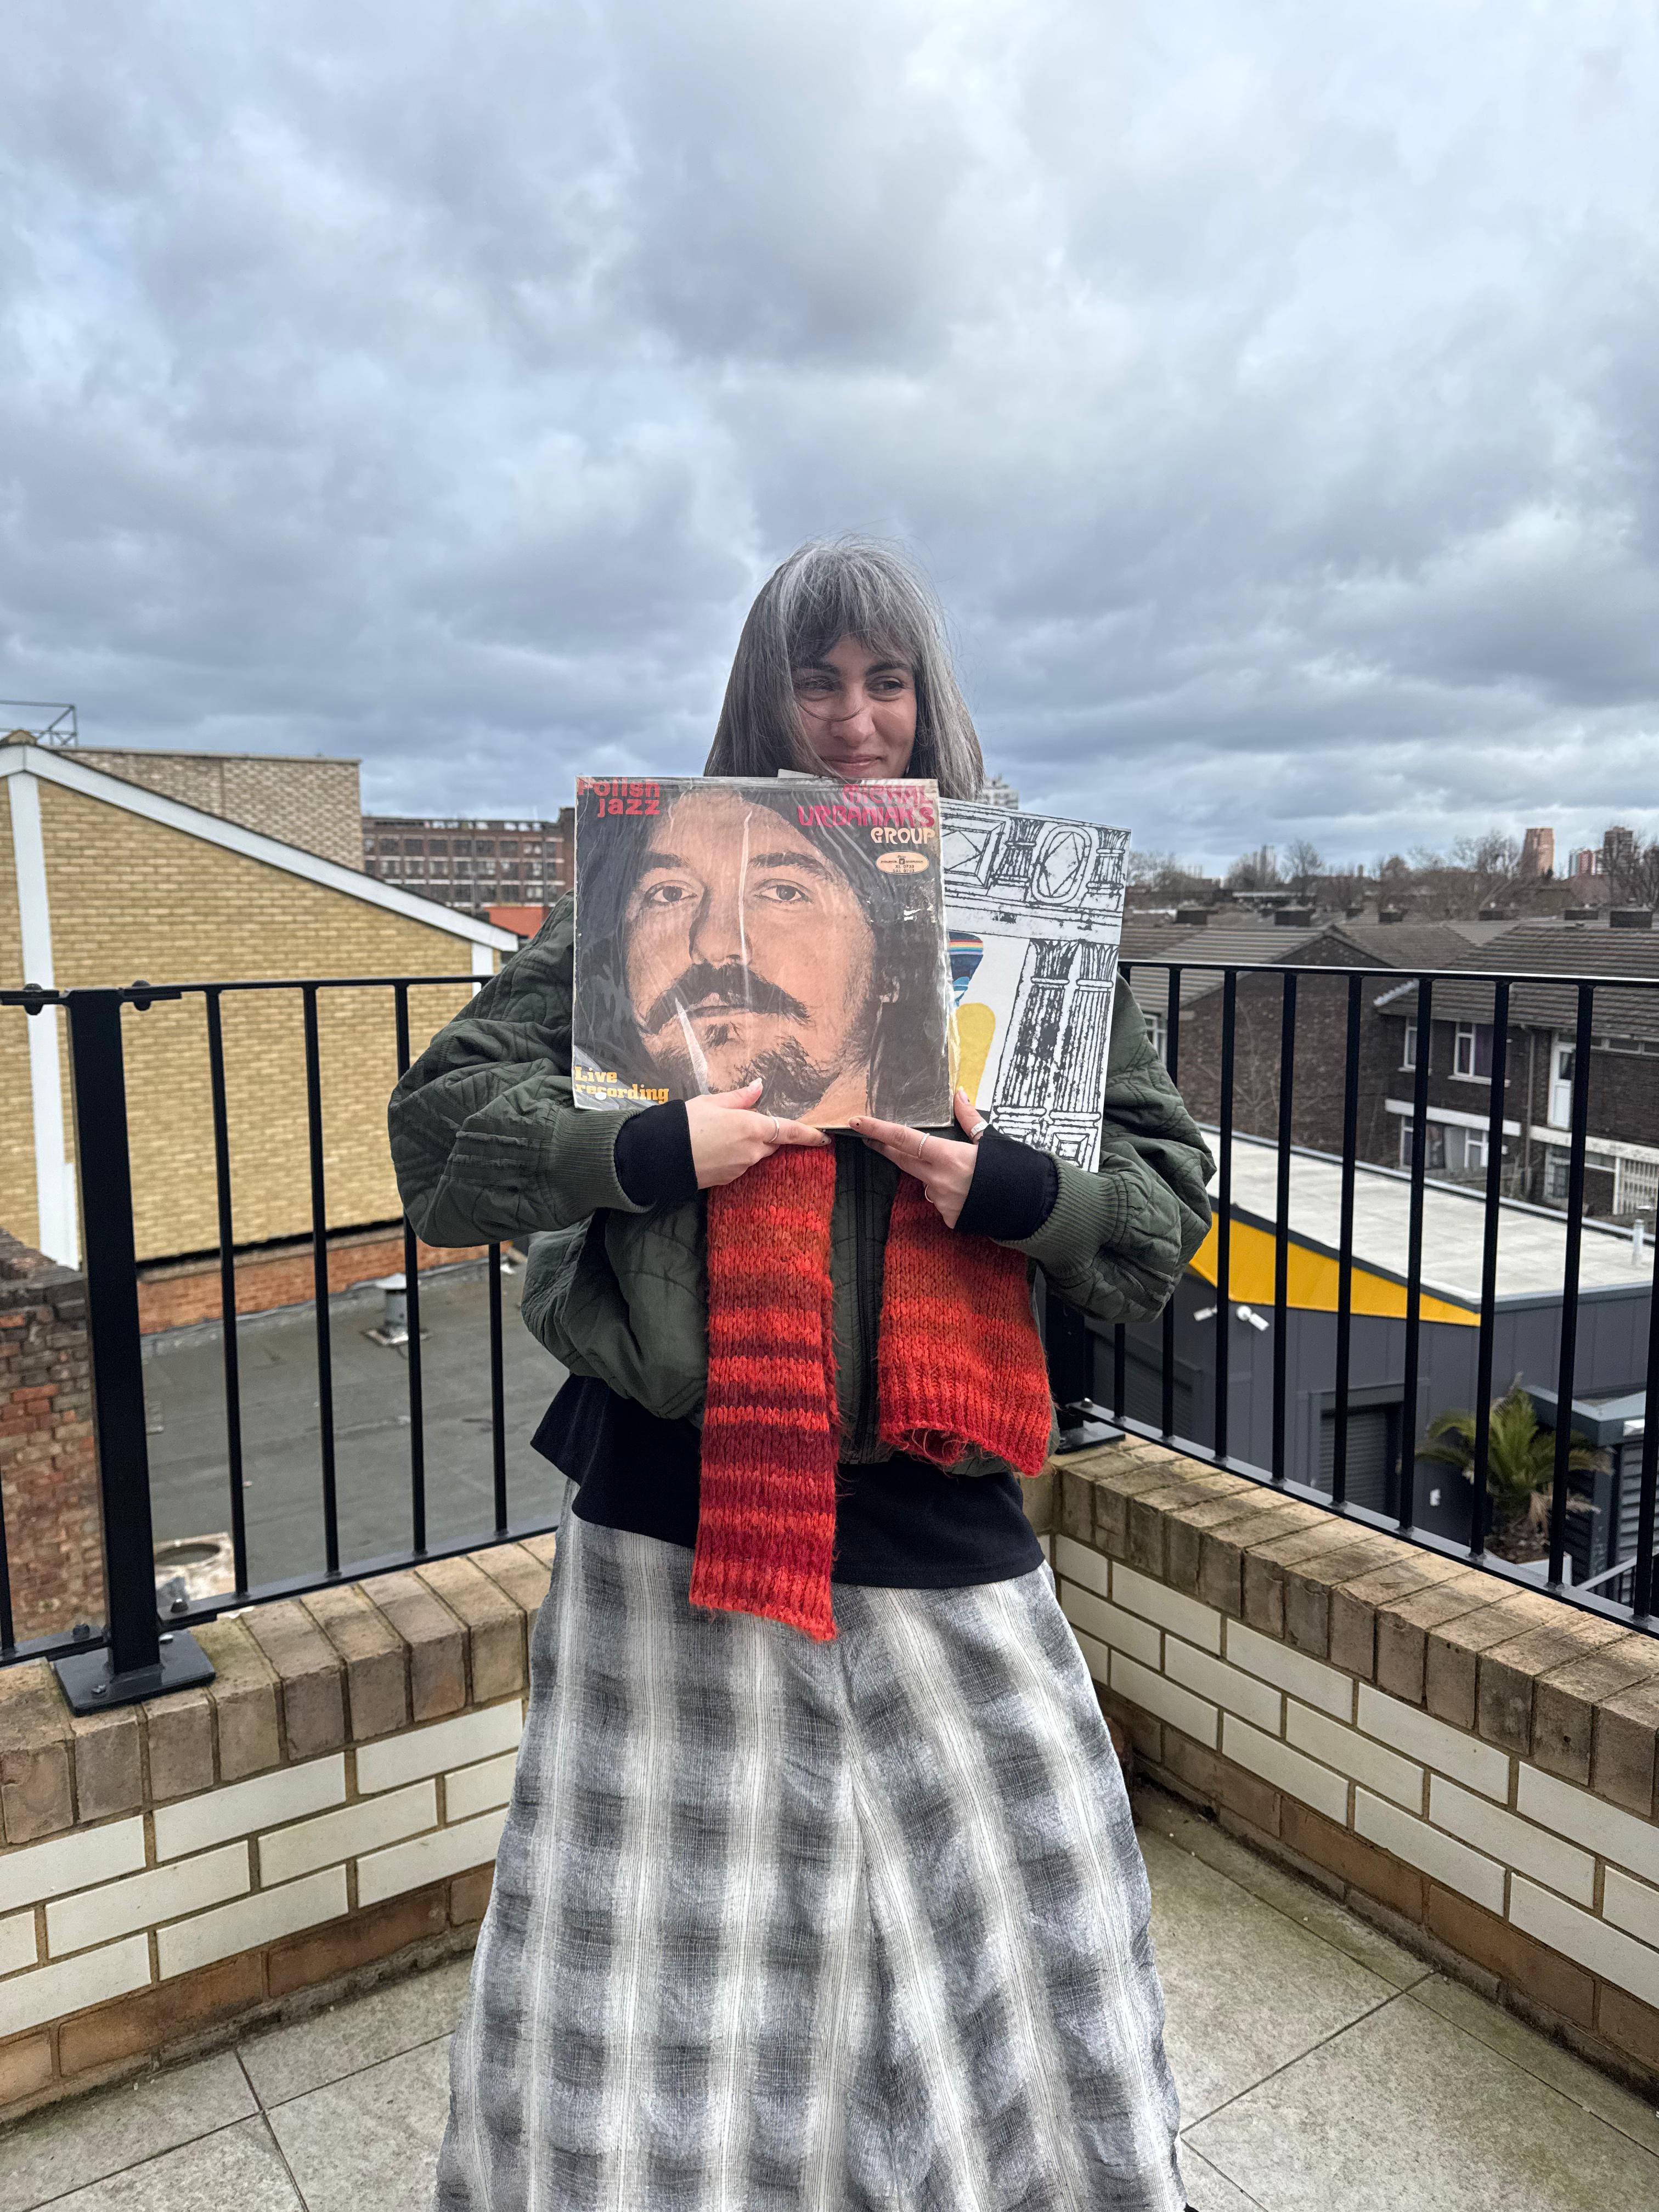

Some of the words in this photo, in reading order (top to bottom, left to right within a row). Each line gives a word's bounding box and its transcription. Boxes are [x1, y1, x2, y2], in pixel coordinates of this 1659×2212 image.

[577, 777, 660, 797] Polish
[597, 799, 661, 817] jazz
[871, 827, 935, 844] GROUP
[574, 1066, 617, 1083] Live
[575, 1084, 669, 1104] recording
